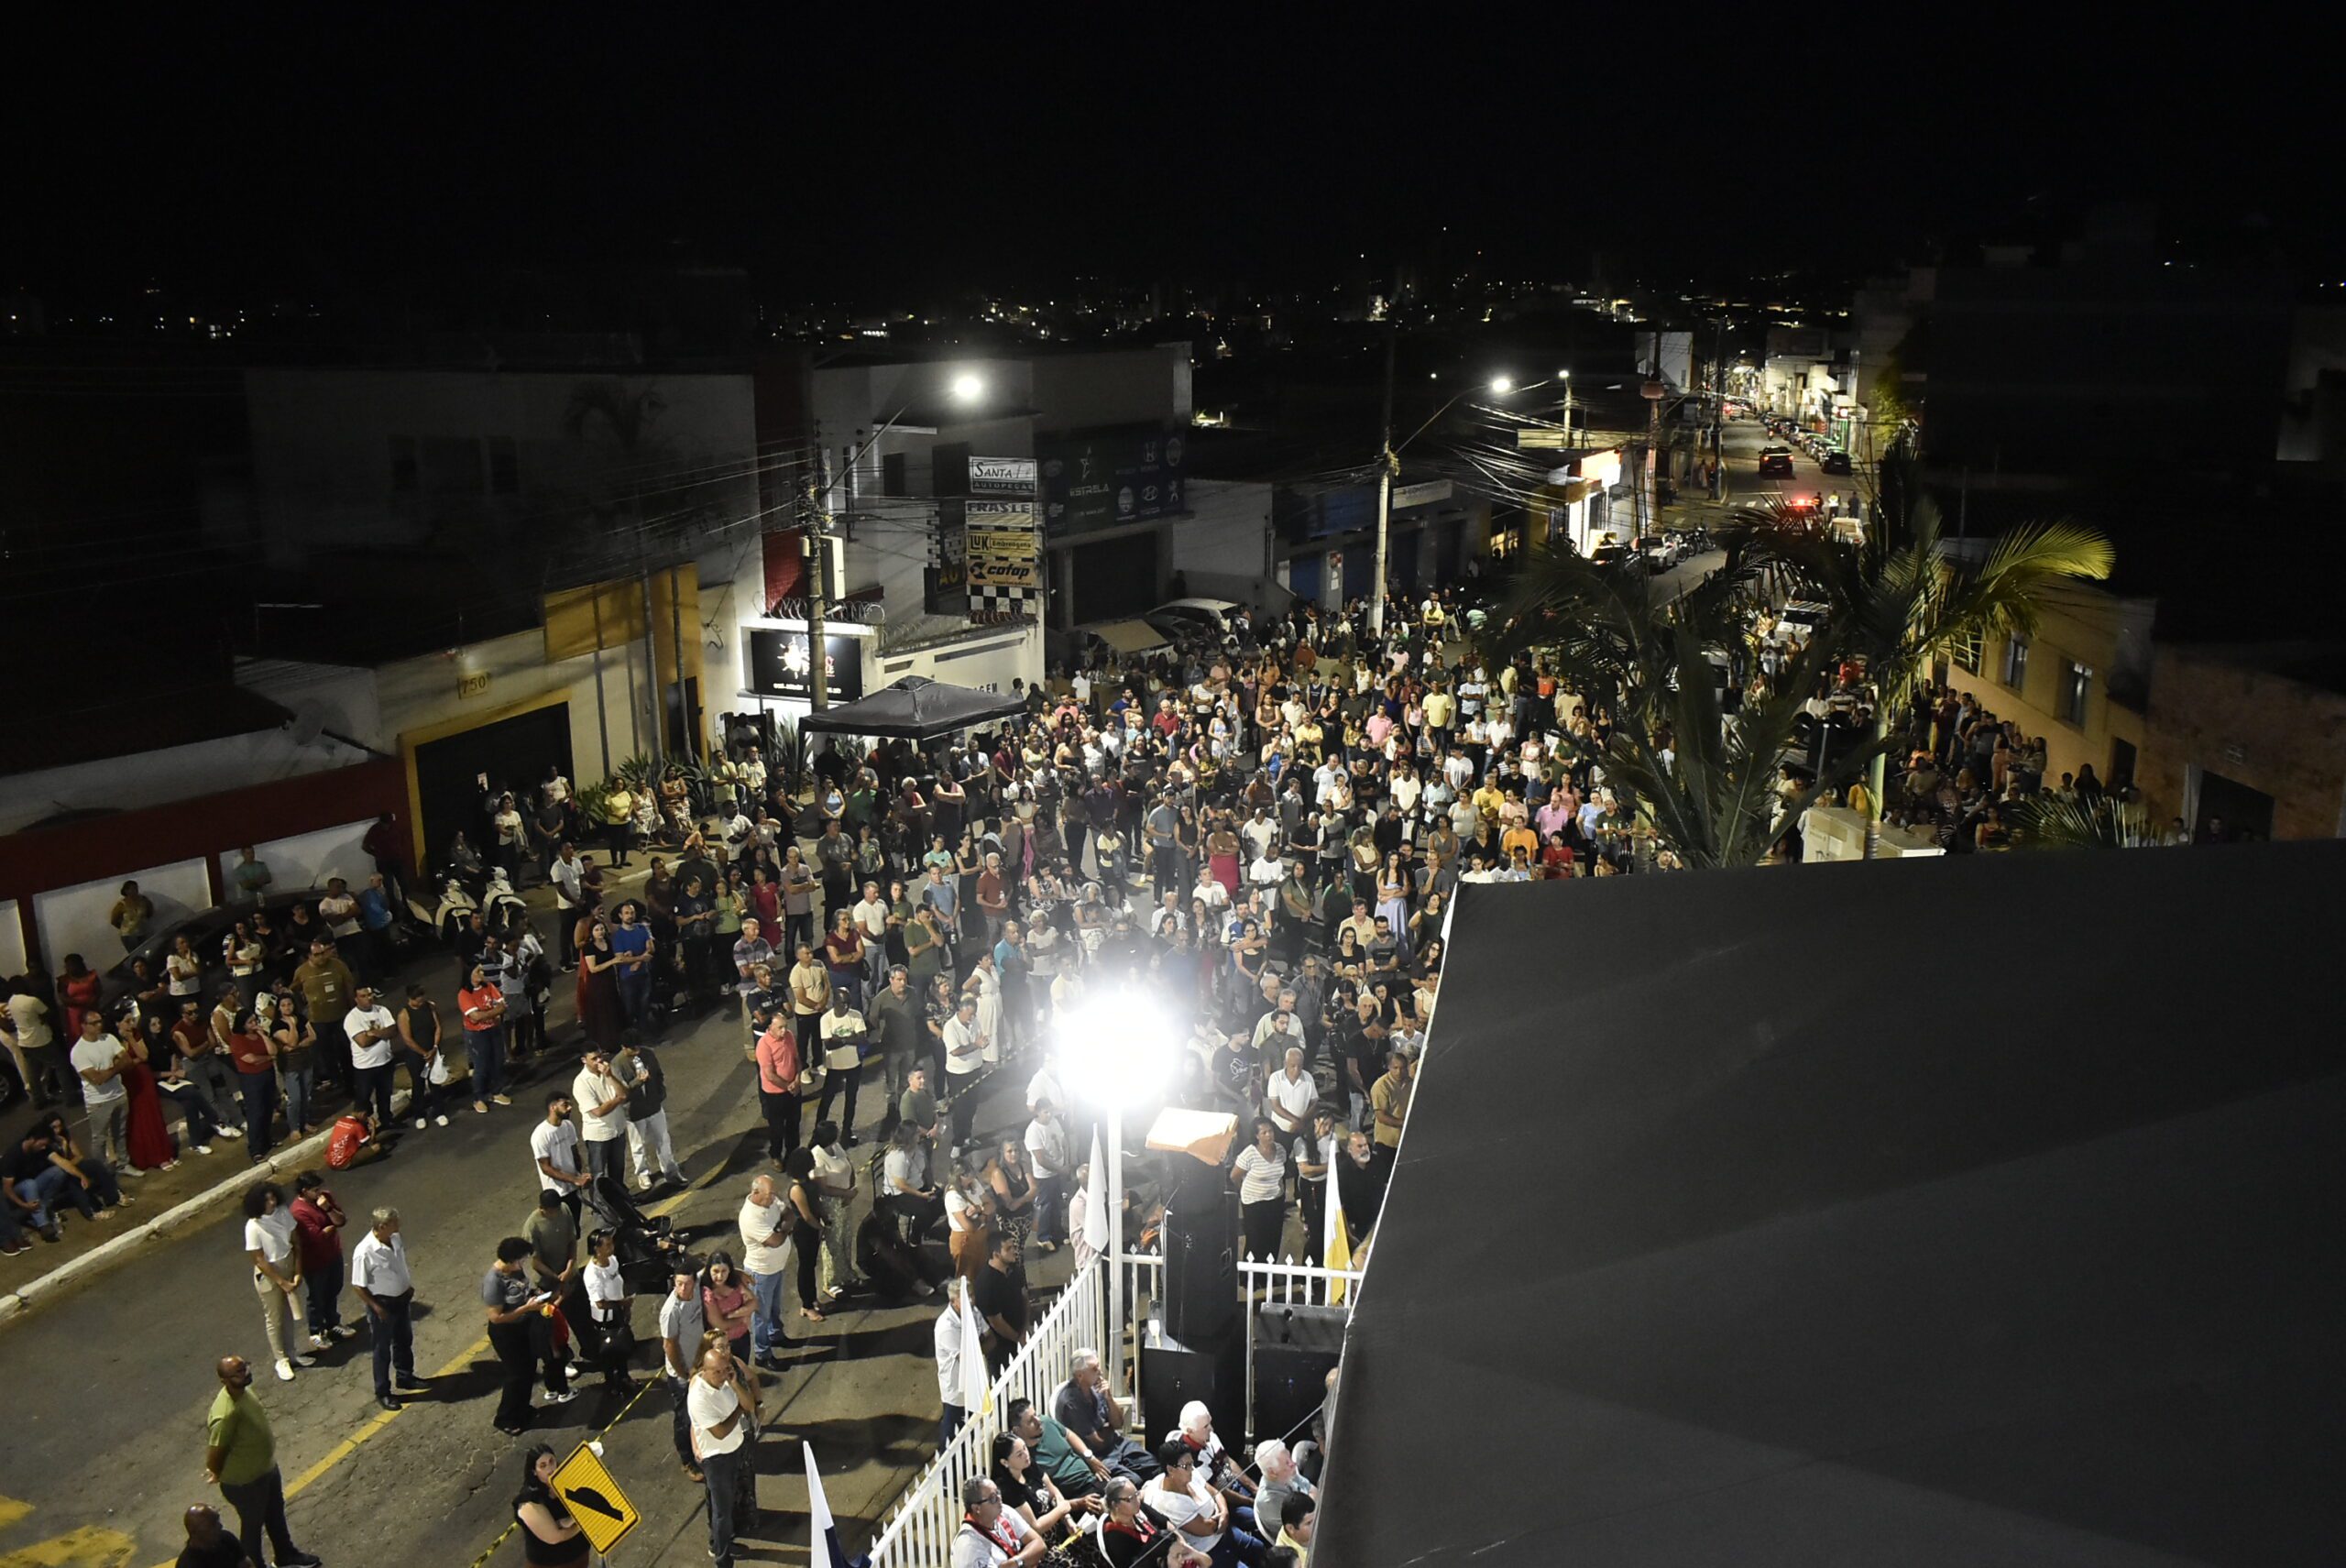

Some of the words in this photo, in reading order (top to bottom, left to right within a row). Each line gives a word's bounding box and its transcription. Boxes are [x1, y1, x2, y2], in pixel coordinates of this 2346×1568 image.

[1069, 484, 1110, 497] ESTRELA
[987, 564, 1030, 579] cofap
[462, 675, 487, 694] 750
